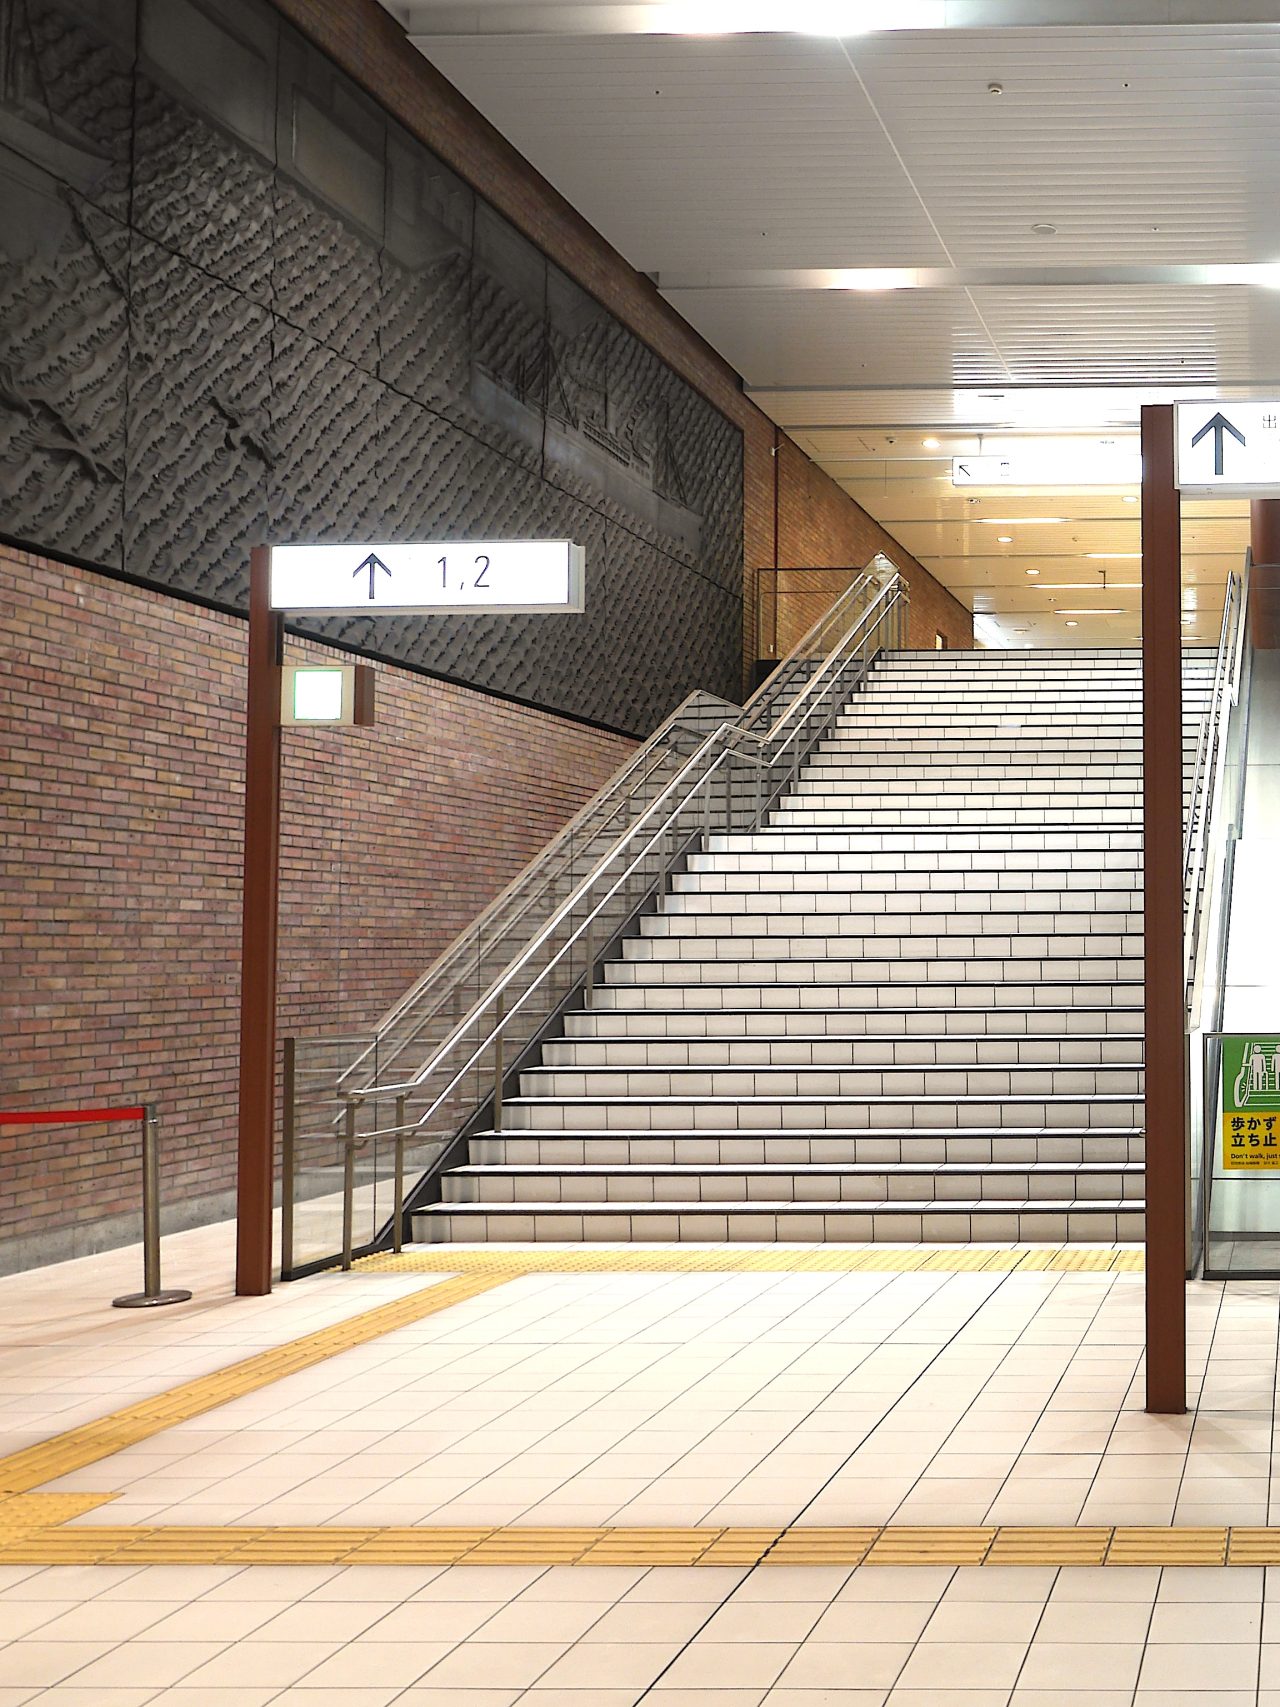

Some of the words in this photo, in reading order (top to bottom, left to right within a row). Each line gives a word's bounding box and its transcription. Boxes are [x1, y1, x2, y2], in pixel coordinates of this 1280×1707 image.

[438, 555, 490, 590] 1,2
[1231, 1116, 1277, 1131] 歩かず
